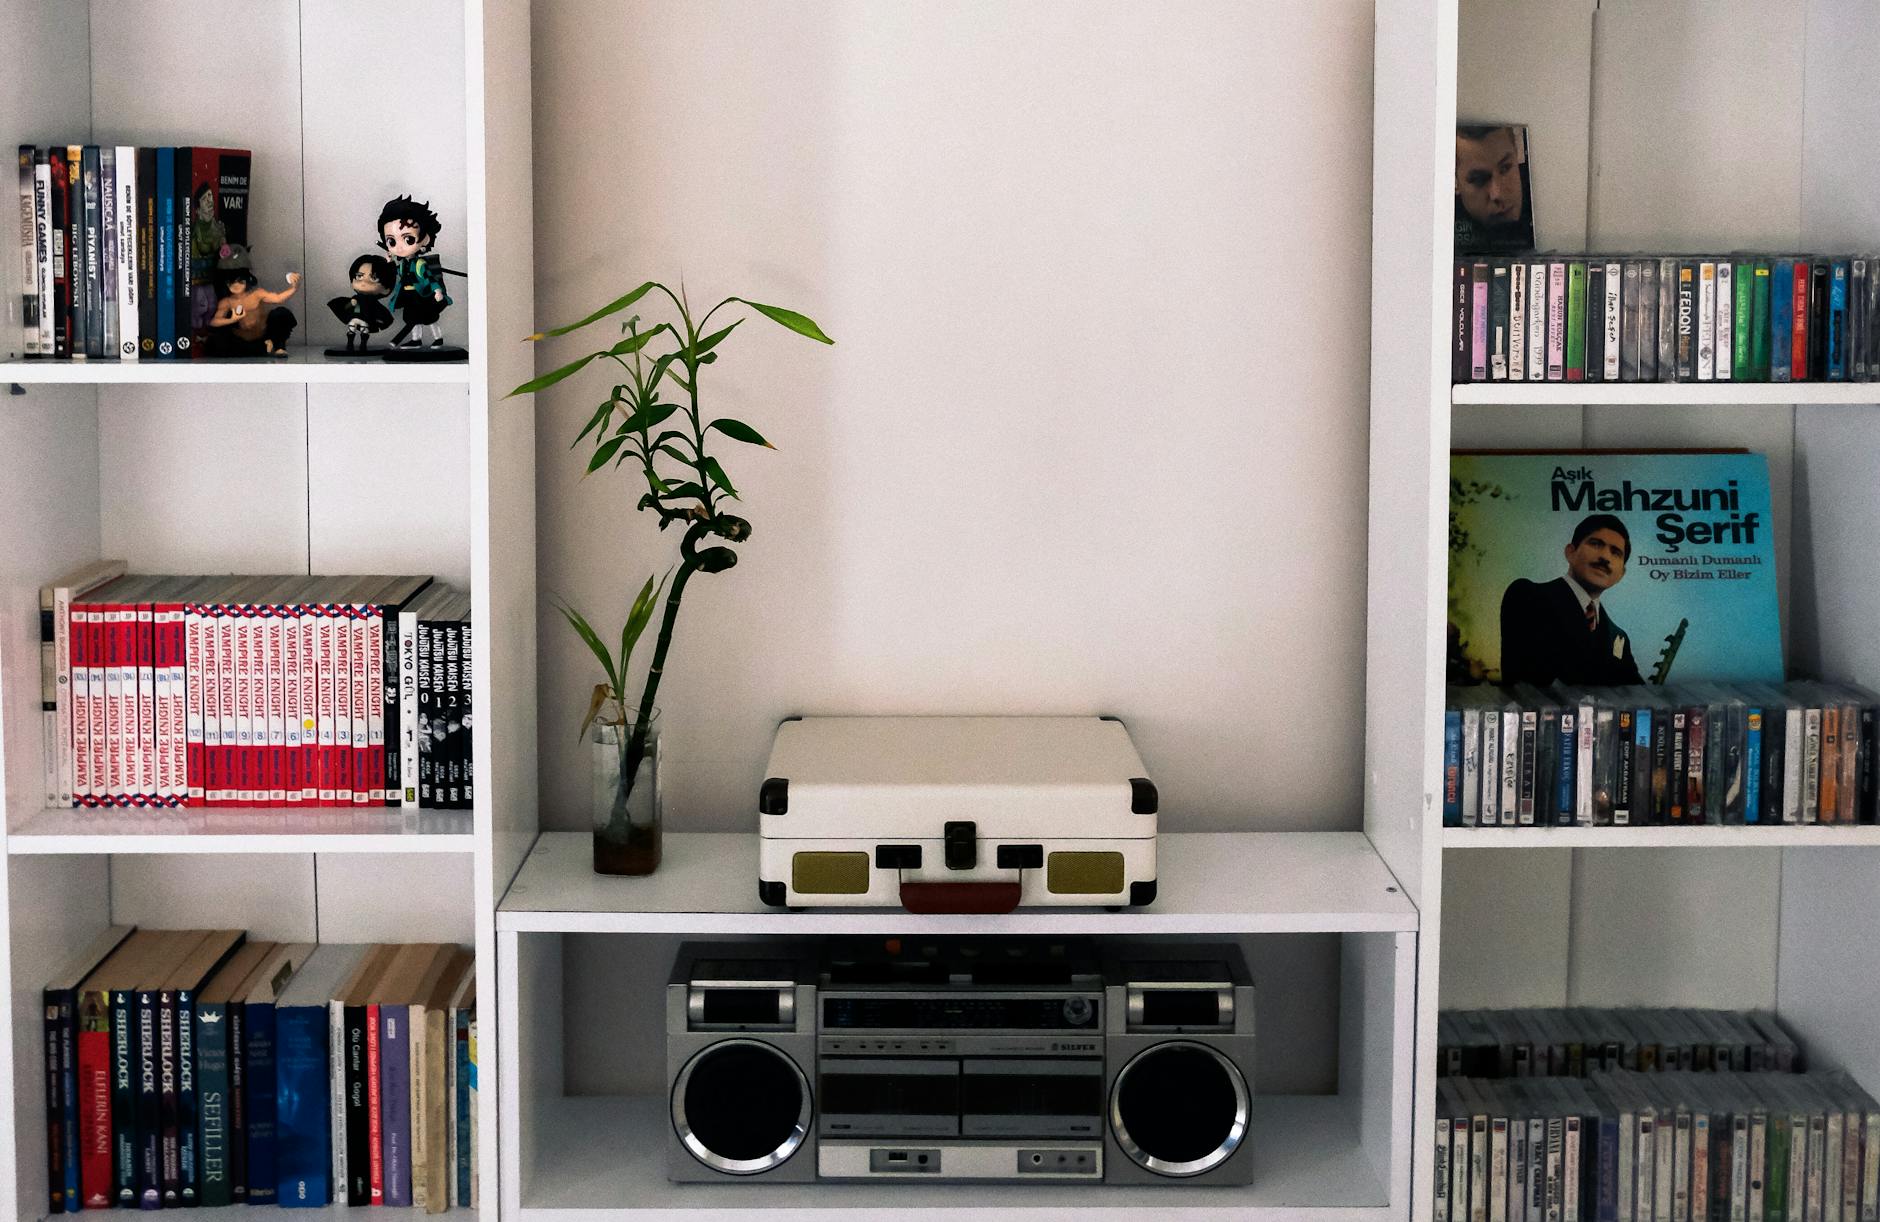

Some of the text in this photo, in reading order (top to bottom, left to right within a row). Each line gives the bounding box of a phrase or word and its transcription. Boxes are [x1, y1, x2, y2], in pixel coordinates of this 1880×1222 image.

[224, 196, 243, 209] VAR!
[239, 176, 247, 185] DE
[20, 195, 33, 247] KAGEMUSHA
[36, 180, 48, 263] FUNNY GAMES
[87, 227, 96, 279] PİYANİST
[1680, 291, 1691, 335] FEDON
[1534, 346, 1543, 366] 1999
[1551, 466, 1592, 484] Aşık
[1551, 480, 1738, 512] Mahzuni
[1656, 514, 1759, 552] Şerif
[1638, 555, 1761, 566] Dumanlı Dumanlı
[1649, 569, 1752, 581] Oy Bizim Eller
[189, 622, 199, 672] VAMPIRE
[205, 625, 215, 674] VAMPIRE
[222, 625, 231, 674] VAMPIRE
[238, 625, 248, 674] VAMPIRE
[253, 626, 263, 674] VAMPIRE
[269, 626, 279, 674] VAMPIRE
[286, 627, 296, 675] VAMPIRE
[302, 624, 313, 672] VAMPIRE
[320, 625, 330, 674] VAMPIRE
[337, 625, 347, 674] VAMPIRE
[353, 628, 363, 676] VAMPIRE
[369, 625, 379, 673] VAMPIRE
[404, 632, 413, 670] TOKYO
[418, 625, 430, 704] JUJUTSU KAISEN 0
[433, 629, 444, 708] JUJUTSU KAISEN 1
[447, 628, 459, 707] JUJUTSU KAISEN 2
[76, 695, 86, 734] KNIGHT
[93, 695, 103, 734] KNIGHT
[109, 694, 119, 734] KNIGHT
[125, 694, 135, 734] KNIGHT
[142, 694, 151, 734] KNIGHT
[158, 695, 169, 734] KNIGHT
[173, 694, 183, 734] KNIGHT
[189, 675, 199, 716] KNIGHT
[206, 678, 216, 719] KNIGHT
[222, 677, 233, 718] KNIGHT
[239, 678, 249, 719] KNIGHT
[254, 678, 264, 719] KNIGHT
[270, 678, 281, 719] KNIGHT
[287, 679, 297, 720] KNIGHT
[303, 676, 314, 717] KNIGHT
[321, 678, 331, 718] KNIGHT
[338, 677, 348, 718] KNIGHT
[354, 679, 364, 720] KNIGHT
[370, 677, 380, 718] KNIGHT
[464, 695, 472, 705] 3
[78, 738, 87, 787] VAMPIRE
[94, 738, 104, 788] VAMPIRE
[110, 738, 121, 787] VAMPIRE
[127, 738, 137, 787] VAMPIRE
[143, 738, 153, 786] VAMPIRE
[160, 738, 169, 788] VAMPIRE
[175, 738, 184, 787] VAMPIRE
[1674, 751, 1682, 771] LEVENT
[116, 1009, 128, 1089] SHERLOCK
[141, 1009, 153, 1093] SHERLOCK
[161, 1008, 173, 1093] SHERLOCK
[179, 1010, 192, 1092] SHERLOCK
[351, 1028, 362, 1107] Ölü Canlar Gogol
[95, 1070, 108, 1154] ELFLERİN KANI
[204, 1092, 223, 1182] SEFİLLER
[1549, 1120, 1561, 1154] NIRVANA
[1534, 1168, 1542, 1207] CHAPMAN
